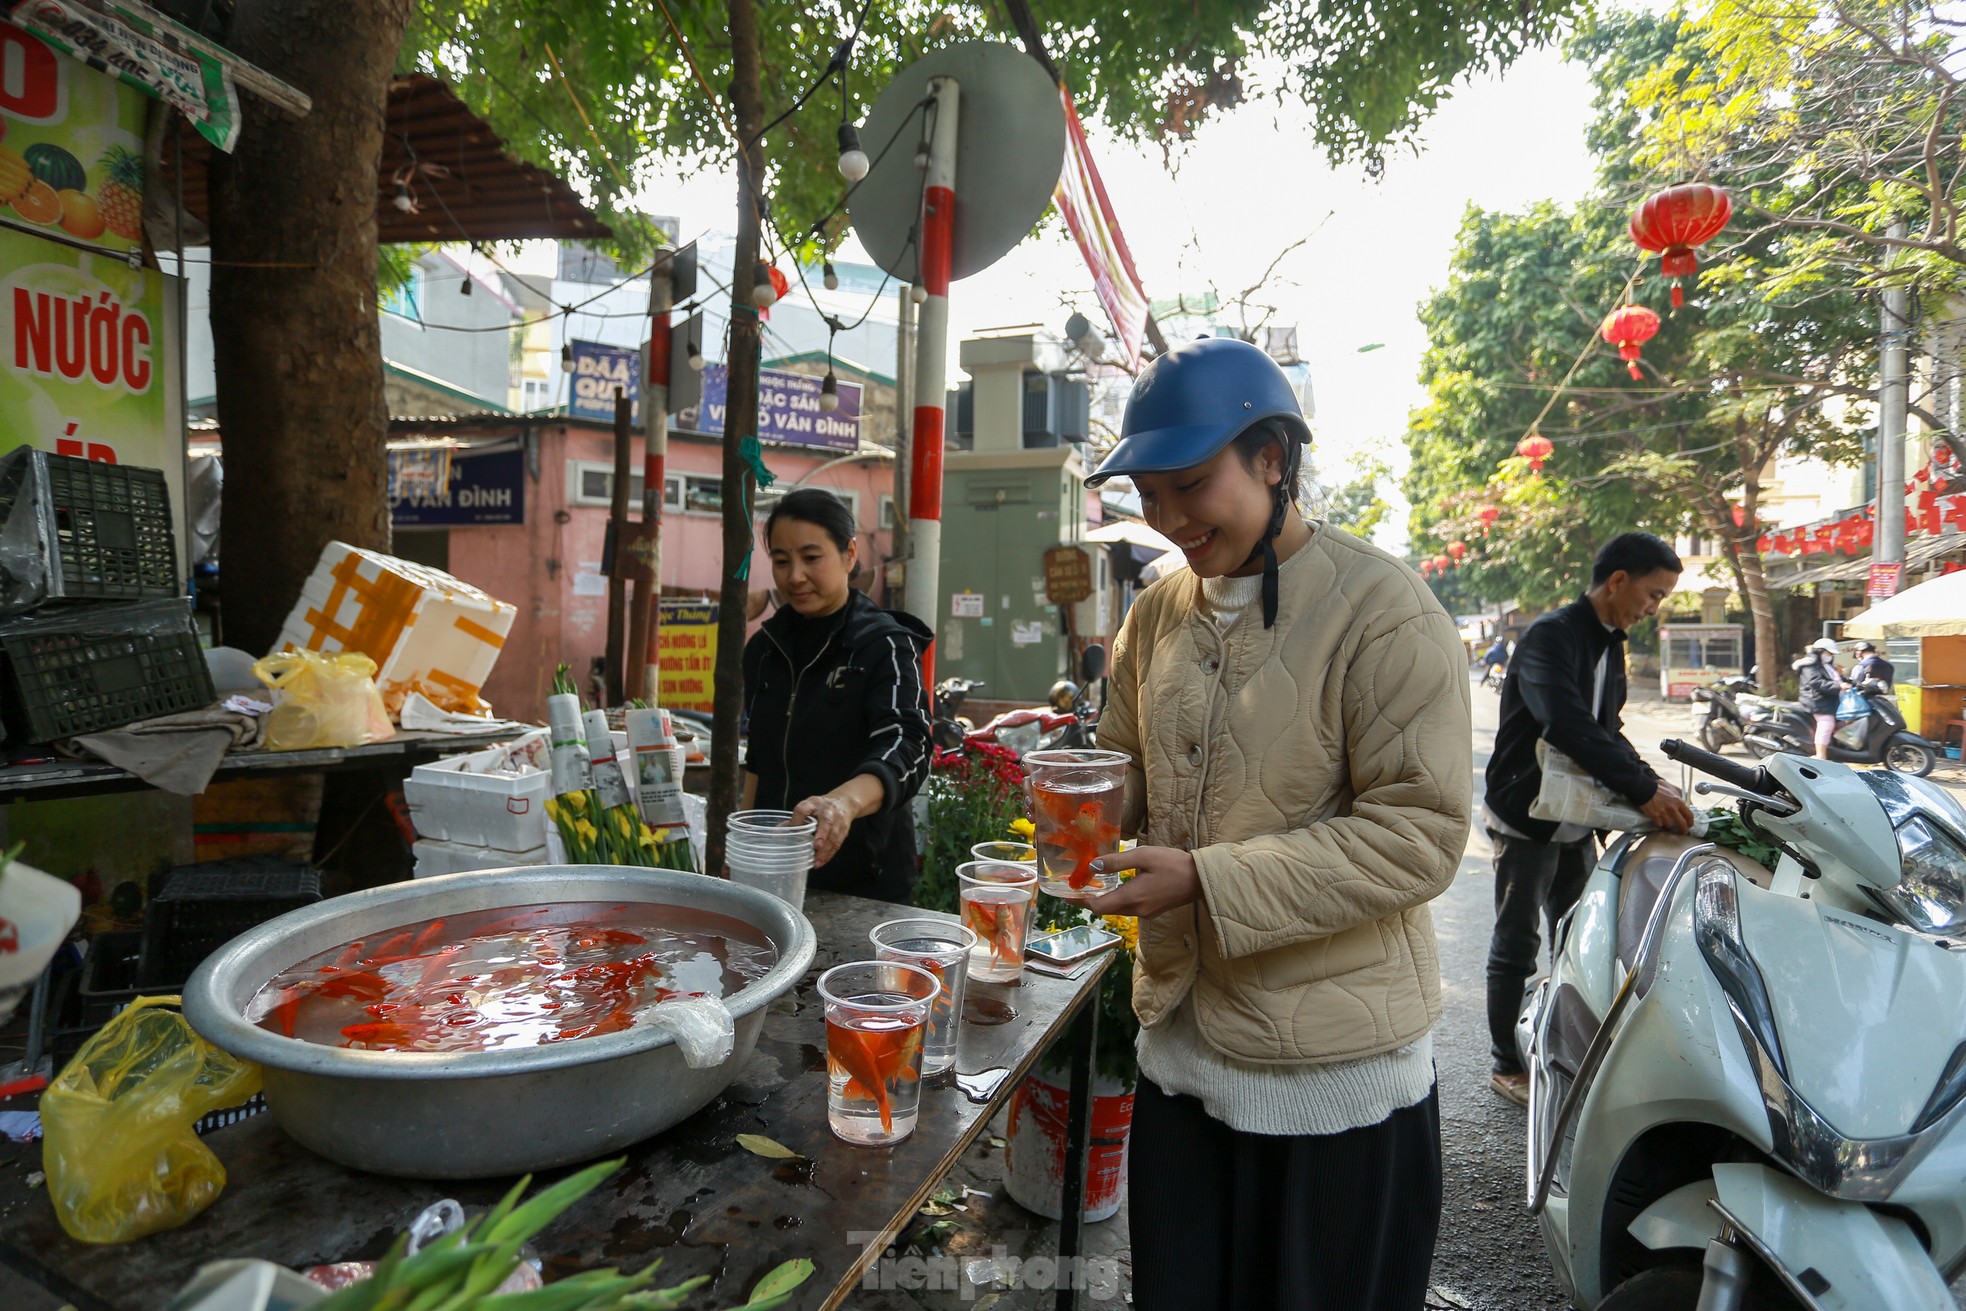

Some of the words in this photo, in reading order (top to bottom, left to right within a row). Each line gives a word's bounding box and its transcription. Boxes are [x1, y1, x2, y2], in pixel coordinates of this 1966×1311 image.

[14, 287, 150, 390] NƯỚC
[775, 413, 812, 432] VÂN
[815, 417, 857, 439] ĐÌNH
[458, 484, 512, 508] ĐÌNH
[1824, 915, 1897, 945] HONDA
